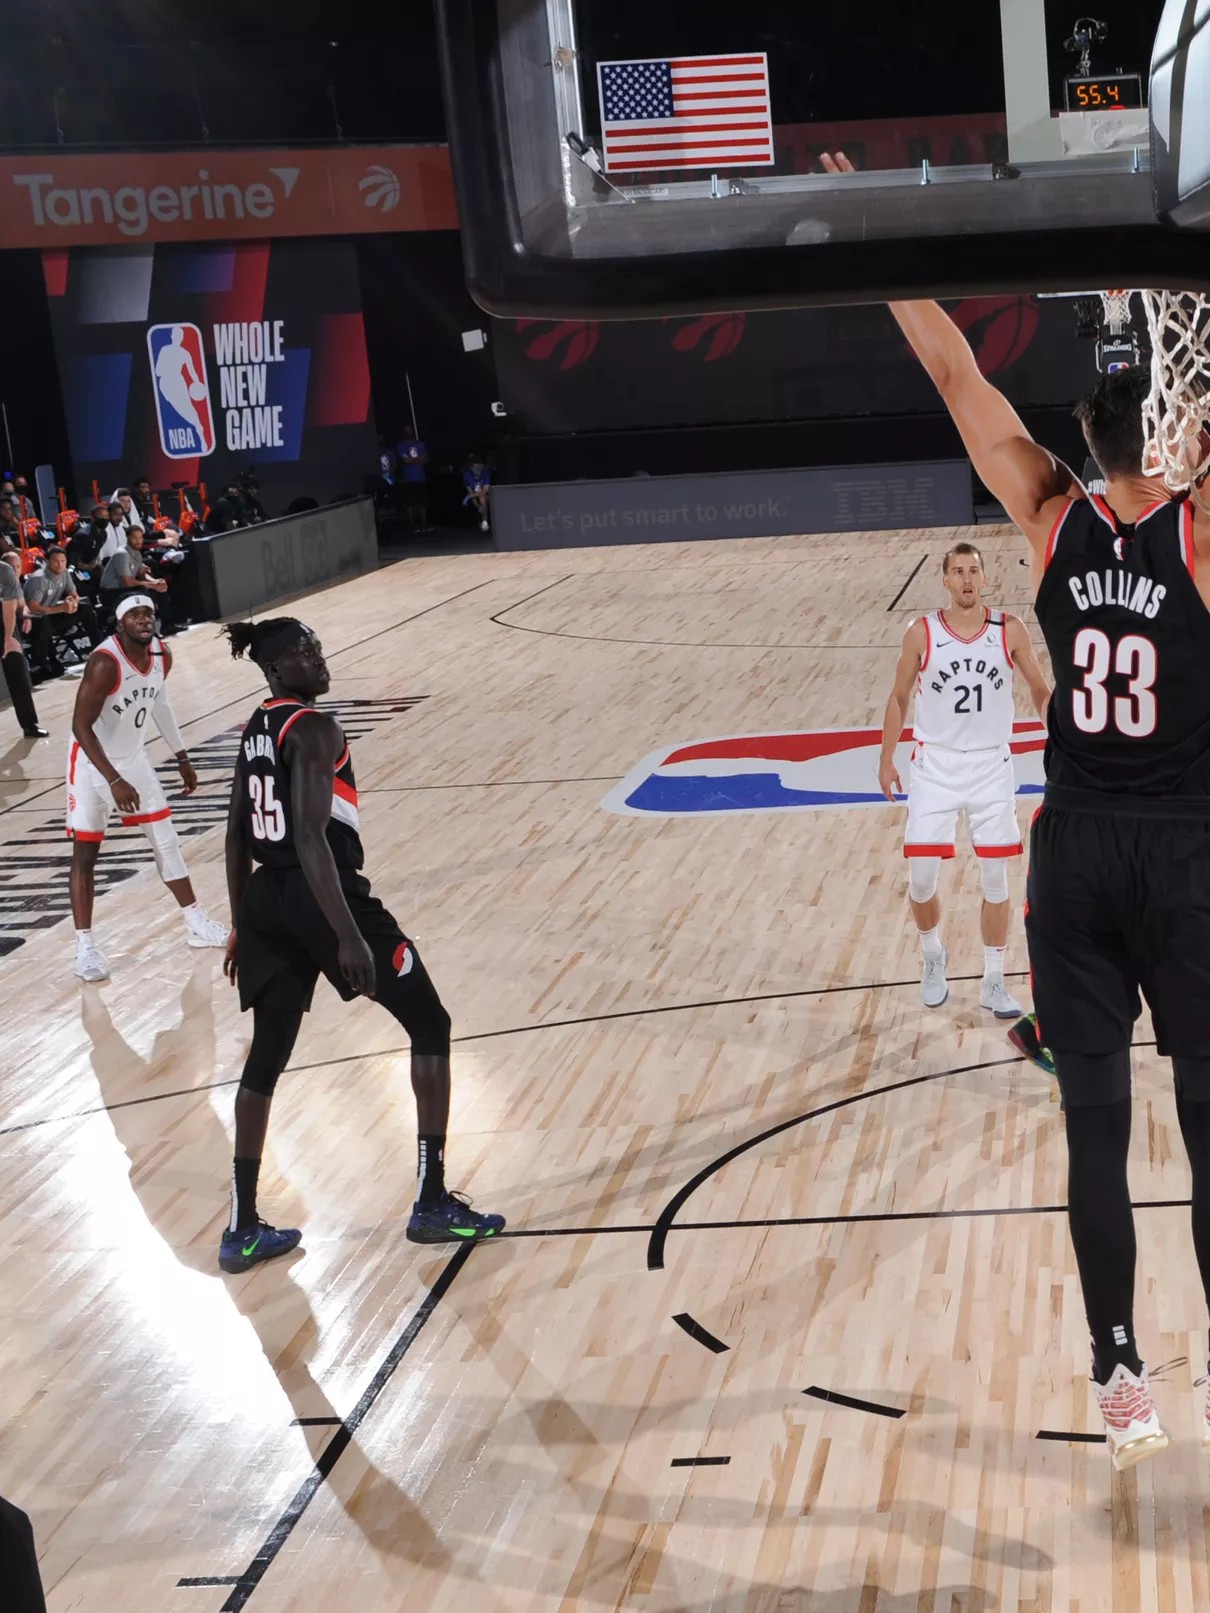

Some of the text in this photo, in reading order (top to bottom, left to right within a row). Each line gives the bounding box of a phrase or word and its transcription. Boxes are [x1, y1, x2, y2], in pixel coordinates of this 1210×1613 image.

[1076, 84, 1119, 106] 55.4
[13, 169, 275, 236] Tangerine
[213, 320, 285, 366] WHOLE
[219, 364, 267, 409] NEW
[168, 427, 196, 450] NBA
[225, 405, 284, 452] GAME
[520, 507, 574, 533] Let's
[579, 507, 619, 534] put
[622, 504, 690, 527] smart
[696, 501, 719, 522] to
[832, 478, 935, 525] IBM
[1067, 569, 1167, 619] COLLINS
[931, 658, 1004, 694] RAPTORS
[954, 683, 982, 714] 21
[1072, 627, 1158, 738] 33
[134, 707, 147, 729] 0
[248, 774, 287, 842] 35
